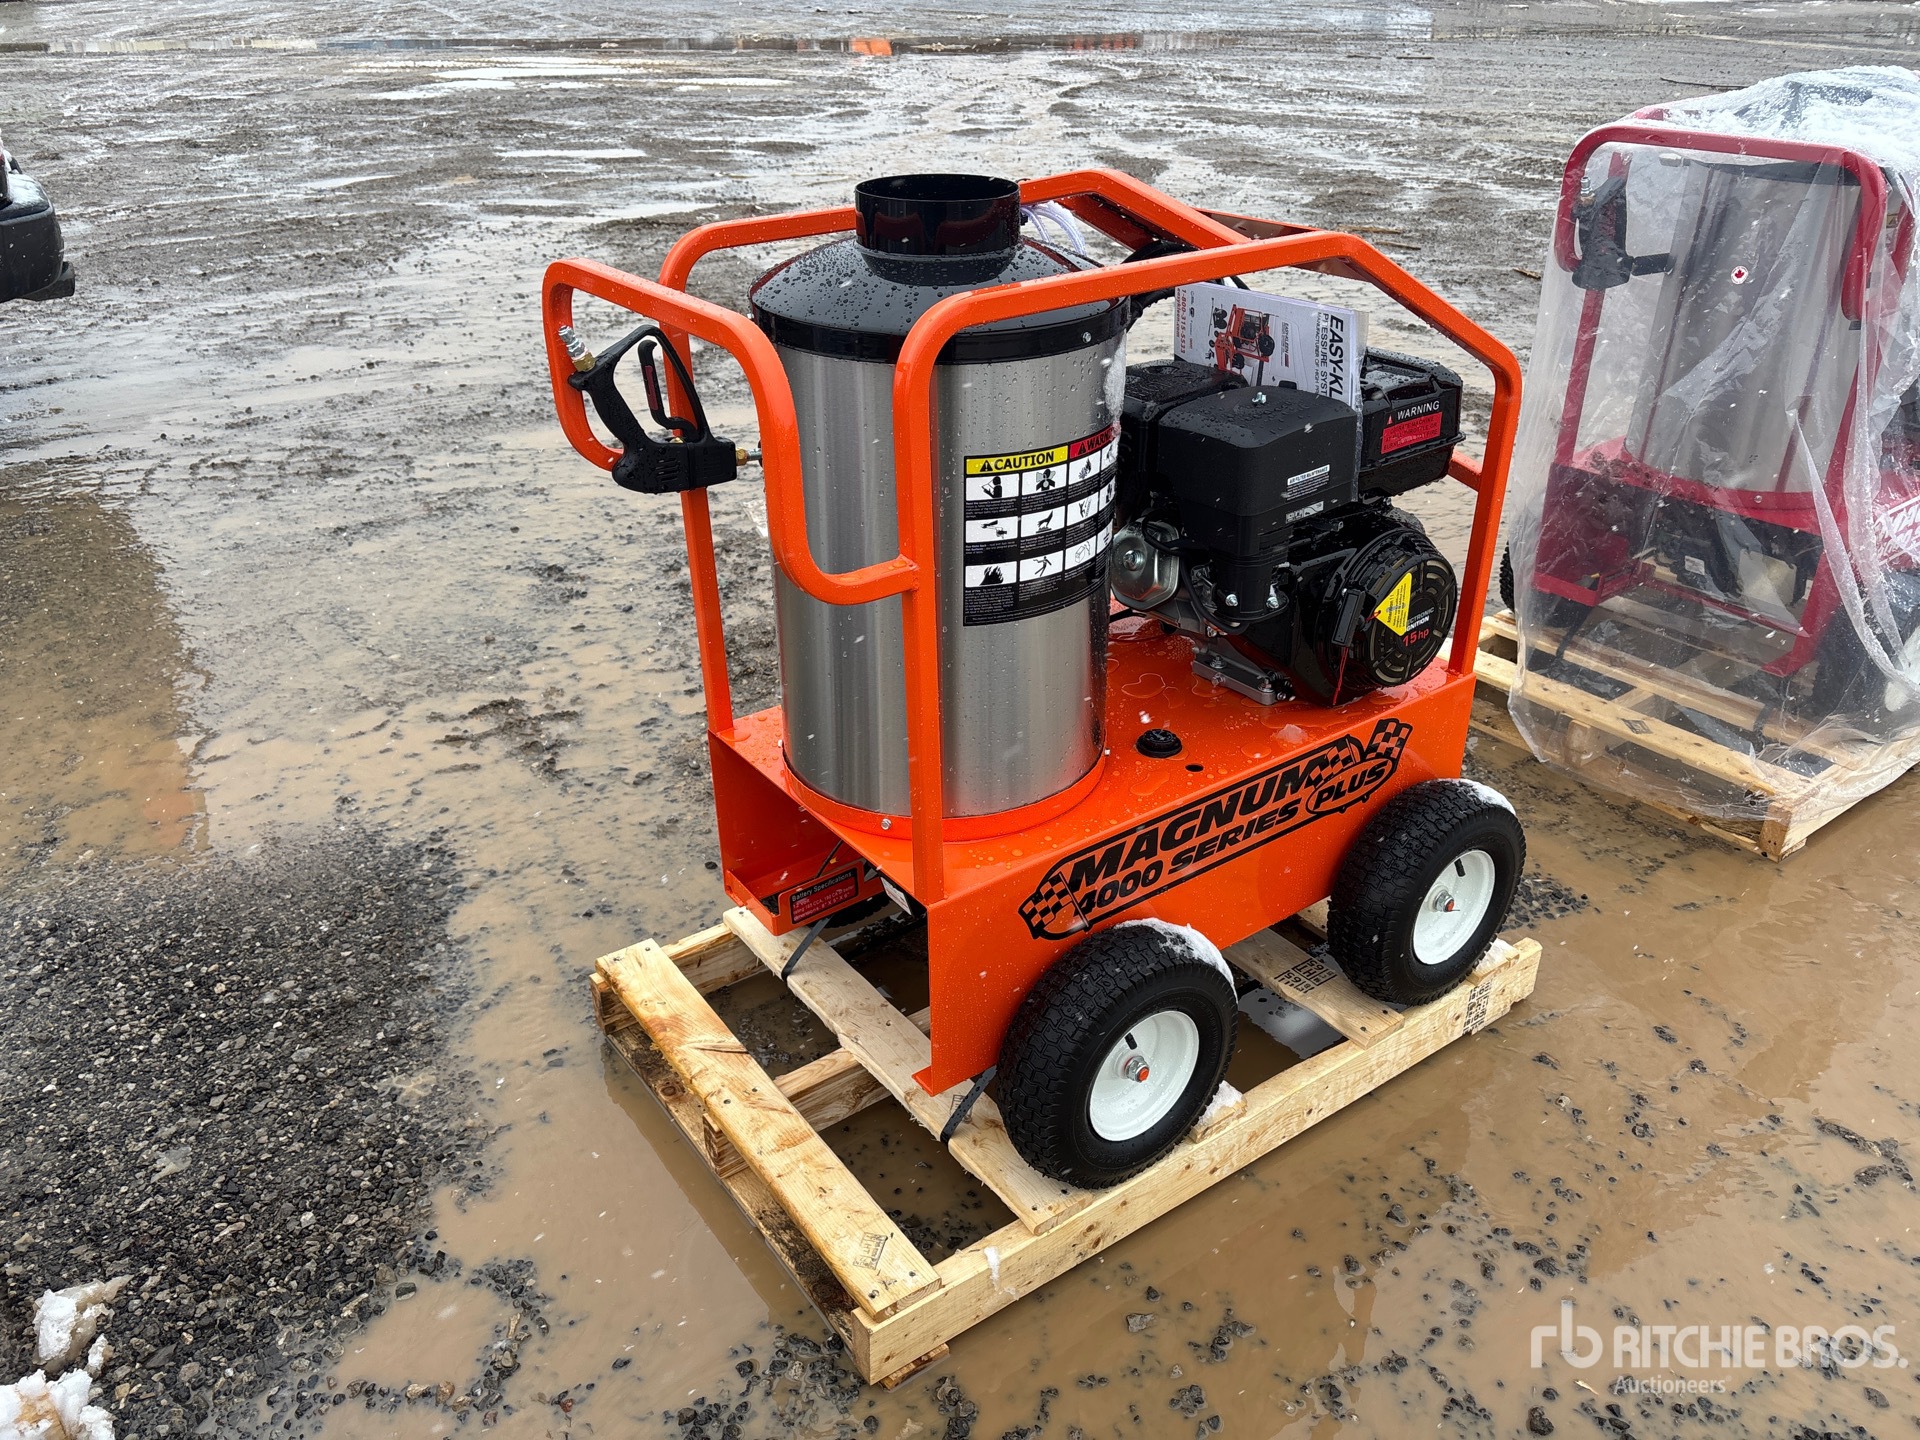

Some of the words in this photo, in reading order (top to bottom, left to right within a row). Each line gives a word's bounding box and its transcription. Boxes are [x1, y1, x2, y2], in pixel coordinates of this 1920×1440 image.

[1329, 315, 1343, 397] EASY-KL
[1397, 401, 1440, 420] WARNING
[994, 451, 1054, 471] CAUTION
[1406, 615, 1430, 631] GNITION
[1313, 760, 1389, 810] PLUS
[1067, 754, 1328, 894] MAGNUM
[1073, 860, 1163, 917] 4000
[1167, 798, 1302, 875] SERIES
[792, 889, 813, 902] Battery
[813, 872, 852, 892] Specifications
[1295, 965, 1317, 977] HT
